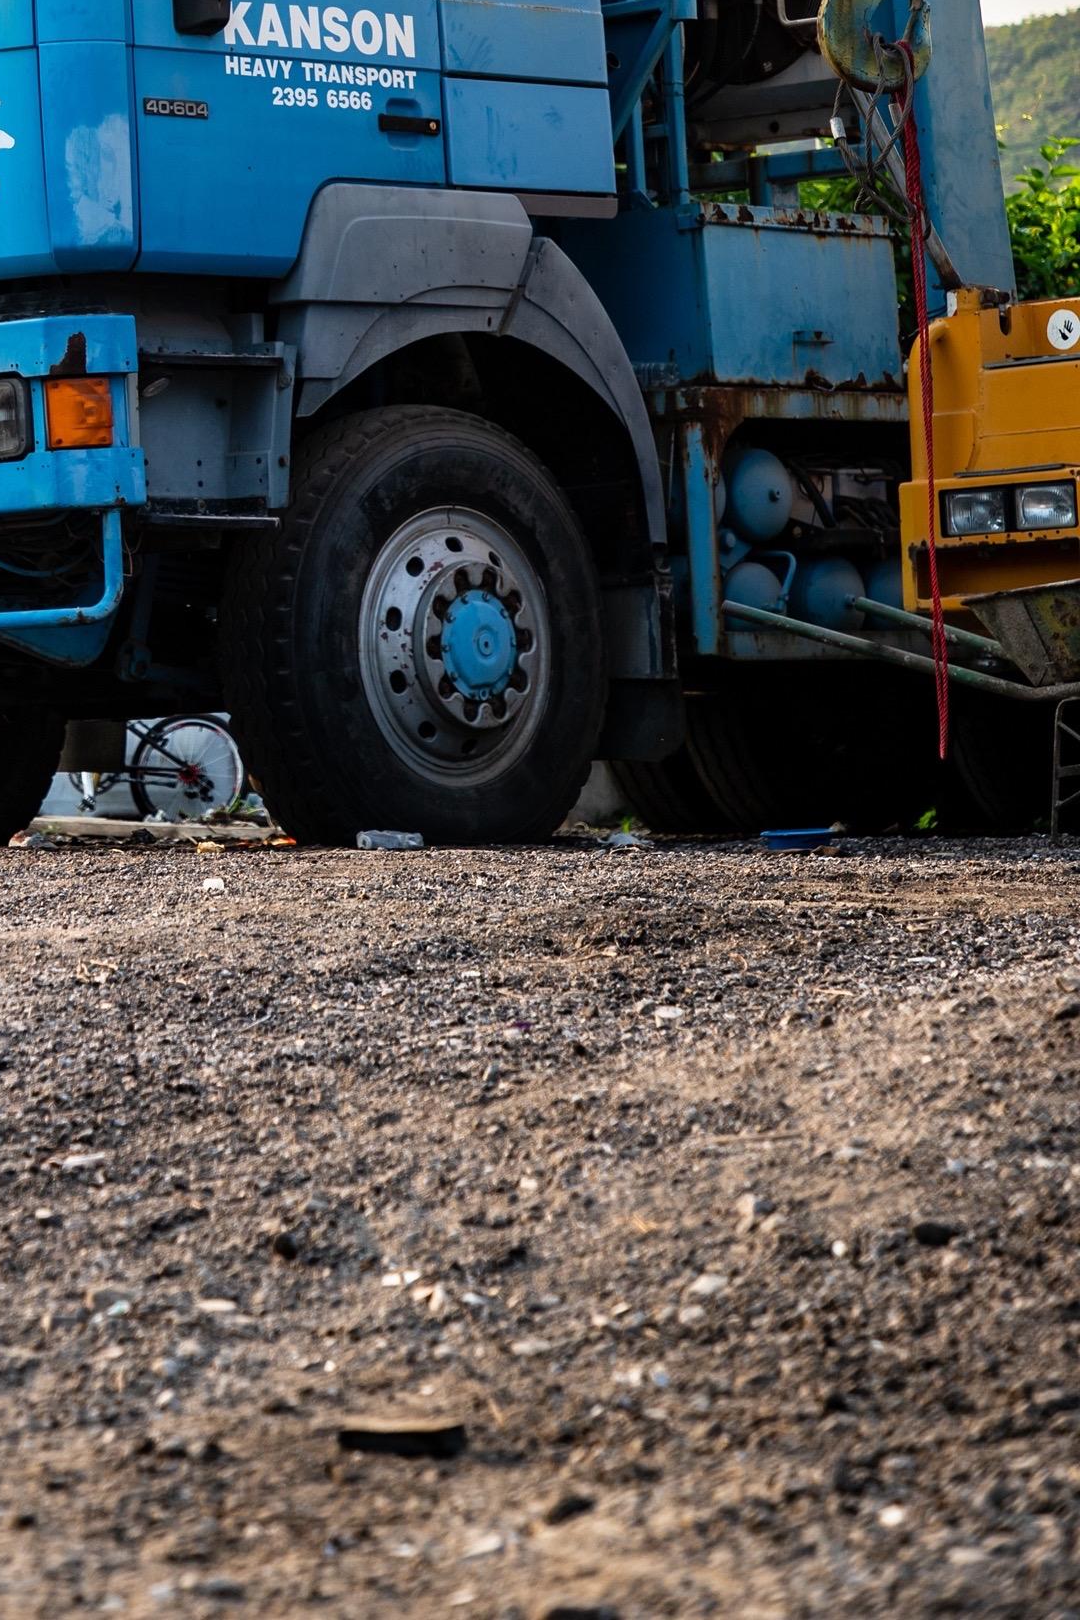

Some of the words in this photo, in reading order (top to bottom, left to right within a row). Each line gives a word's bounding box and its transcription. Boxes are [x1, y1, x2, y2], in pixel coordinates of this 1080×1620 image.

[223, 1, 416, 58] KANSON
[225, 55, 293, 80] HEAVY
[301, 61, 417, 90] TRANSPORT
[272, 86, 319, 108] 2395
[326, 89, 372, 111] 6566
